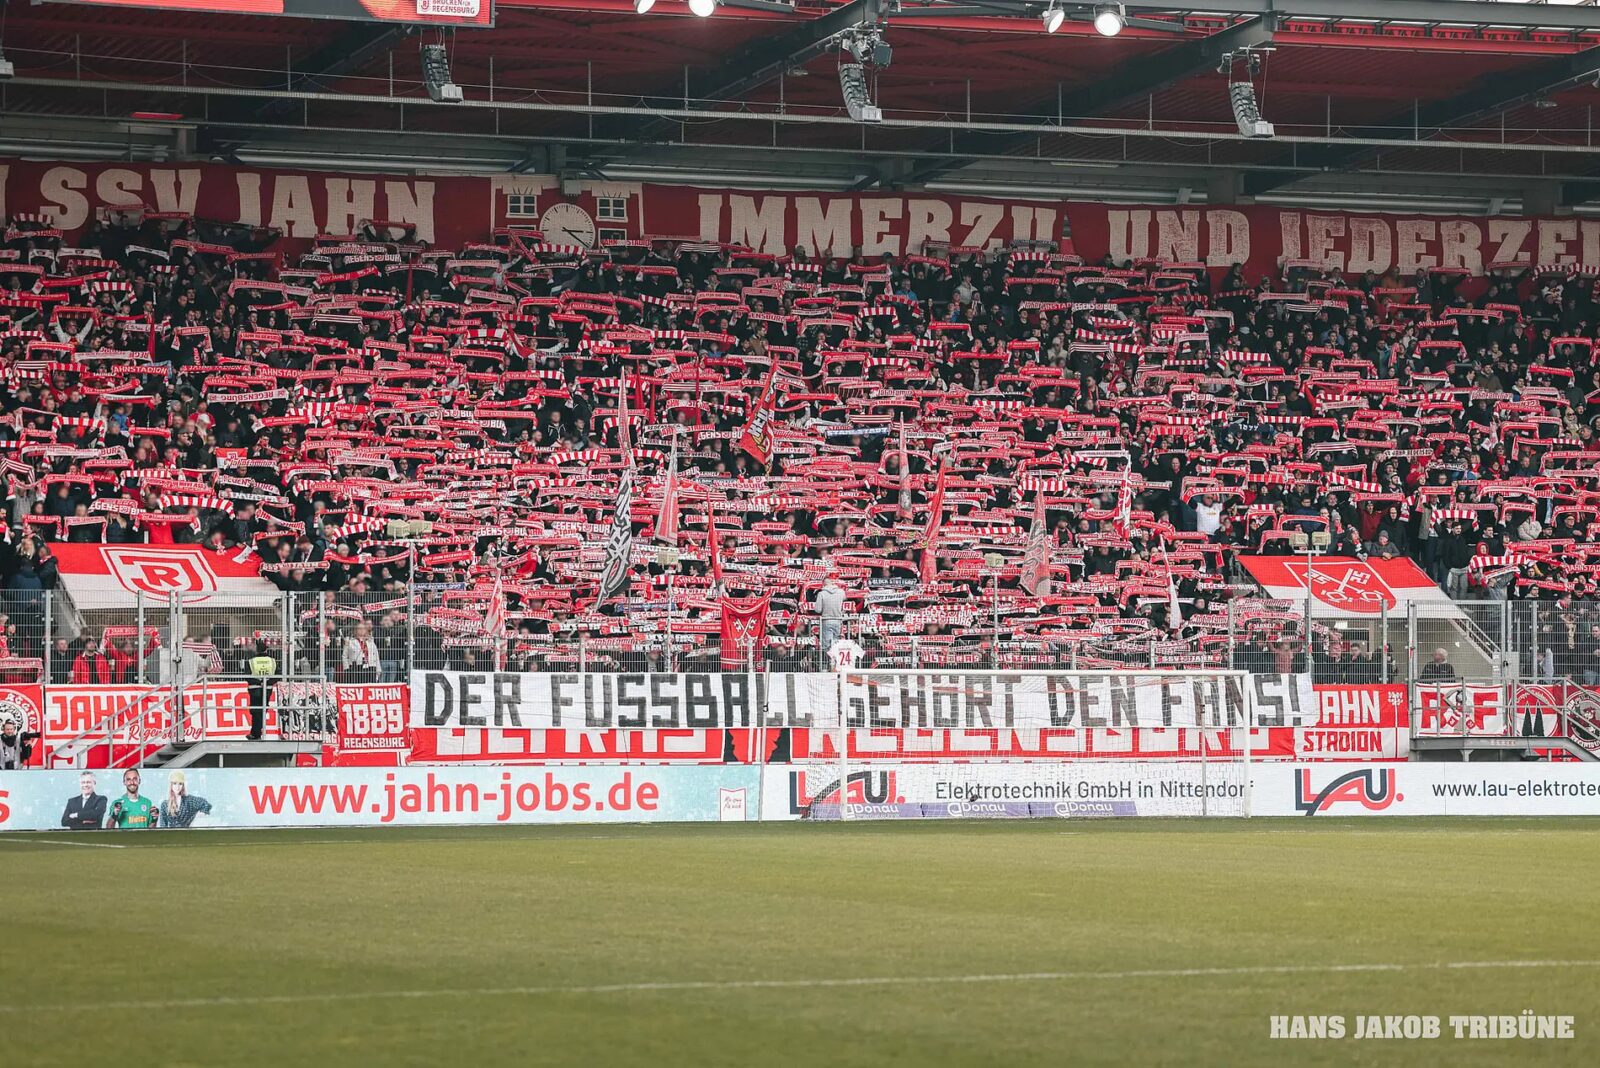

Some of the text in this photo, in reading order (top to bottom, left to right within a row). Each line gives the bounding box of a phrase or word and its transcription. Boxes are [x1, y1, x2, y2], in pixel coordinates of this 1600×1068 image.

[432, 5, 475, 14] REGENSBURG
[40, 166, 201, 230] SSV
[236, 173, 435, 245] JAHN
[698, 194, 1057, 259] IMMERZU
[1107, 210, 1250, 267] UND
[839, 651, 850, 667] 24
[339, 687, 402, 701] SSV JAHN
[424, 673, 522, 727] DER
[550, 673, 814, 728] FUSSBALL
[1046, 674, 1139, 727] DEN
[1161, 674, 1302, 727] FANS!
[341, 703, 405, 735] 1889
[343, 737, 405, 749] REGENSBURG
[1303, 731, 1382, 752] STADION
[249, 772, 660, 822] www.jahn-jobs.de
[936, 781, 1071, 799] Elektrotechnik
[1077, 781, 1132, 798] GmbH
[1138, 781, 1154, 798] in
[962, 802, 1007, 813] Donau
[1070, 801, 1114, 813] Donau
